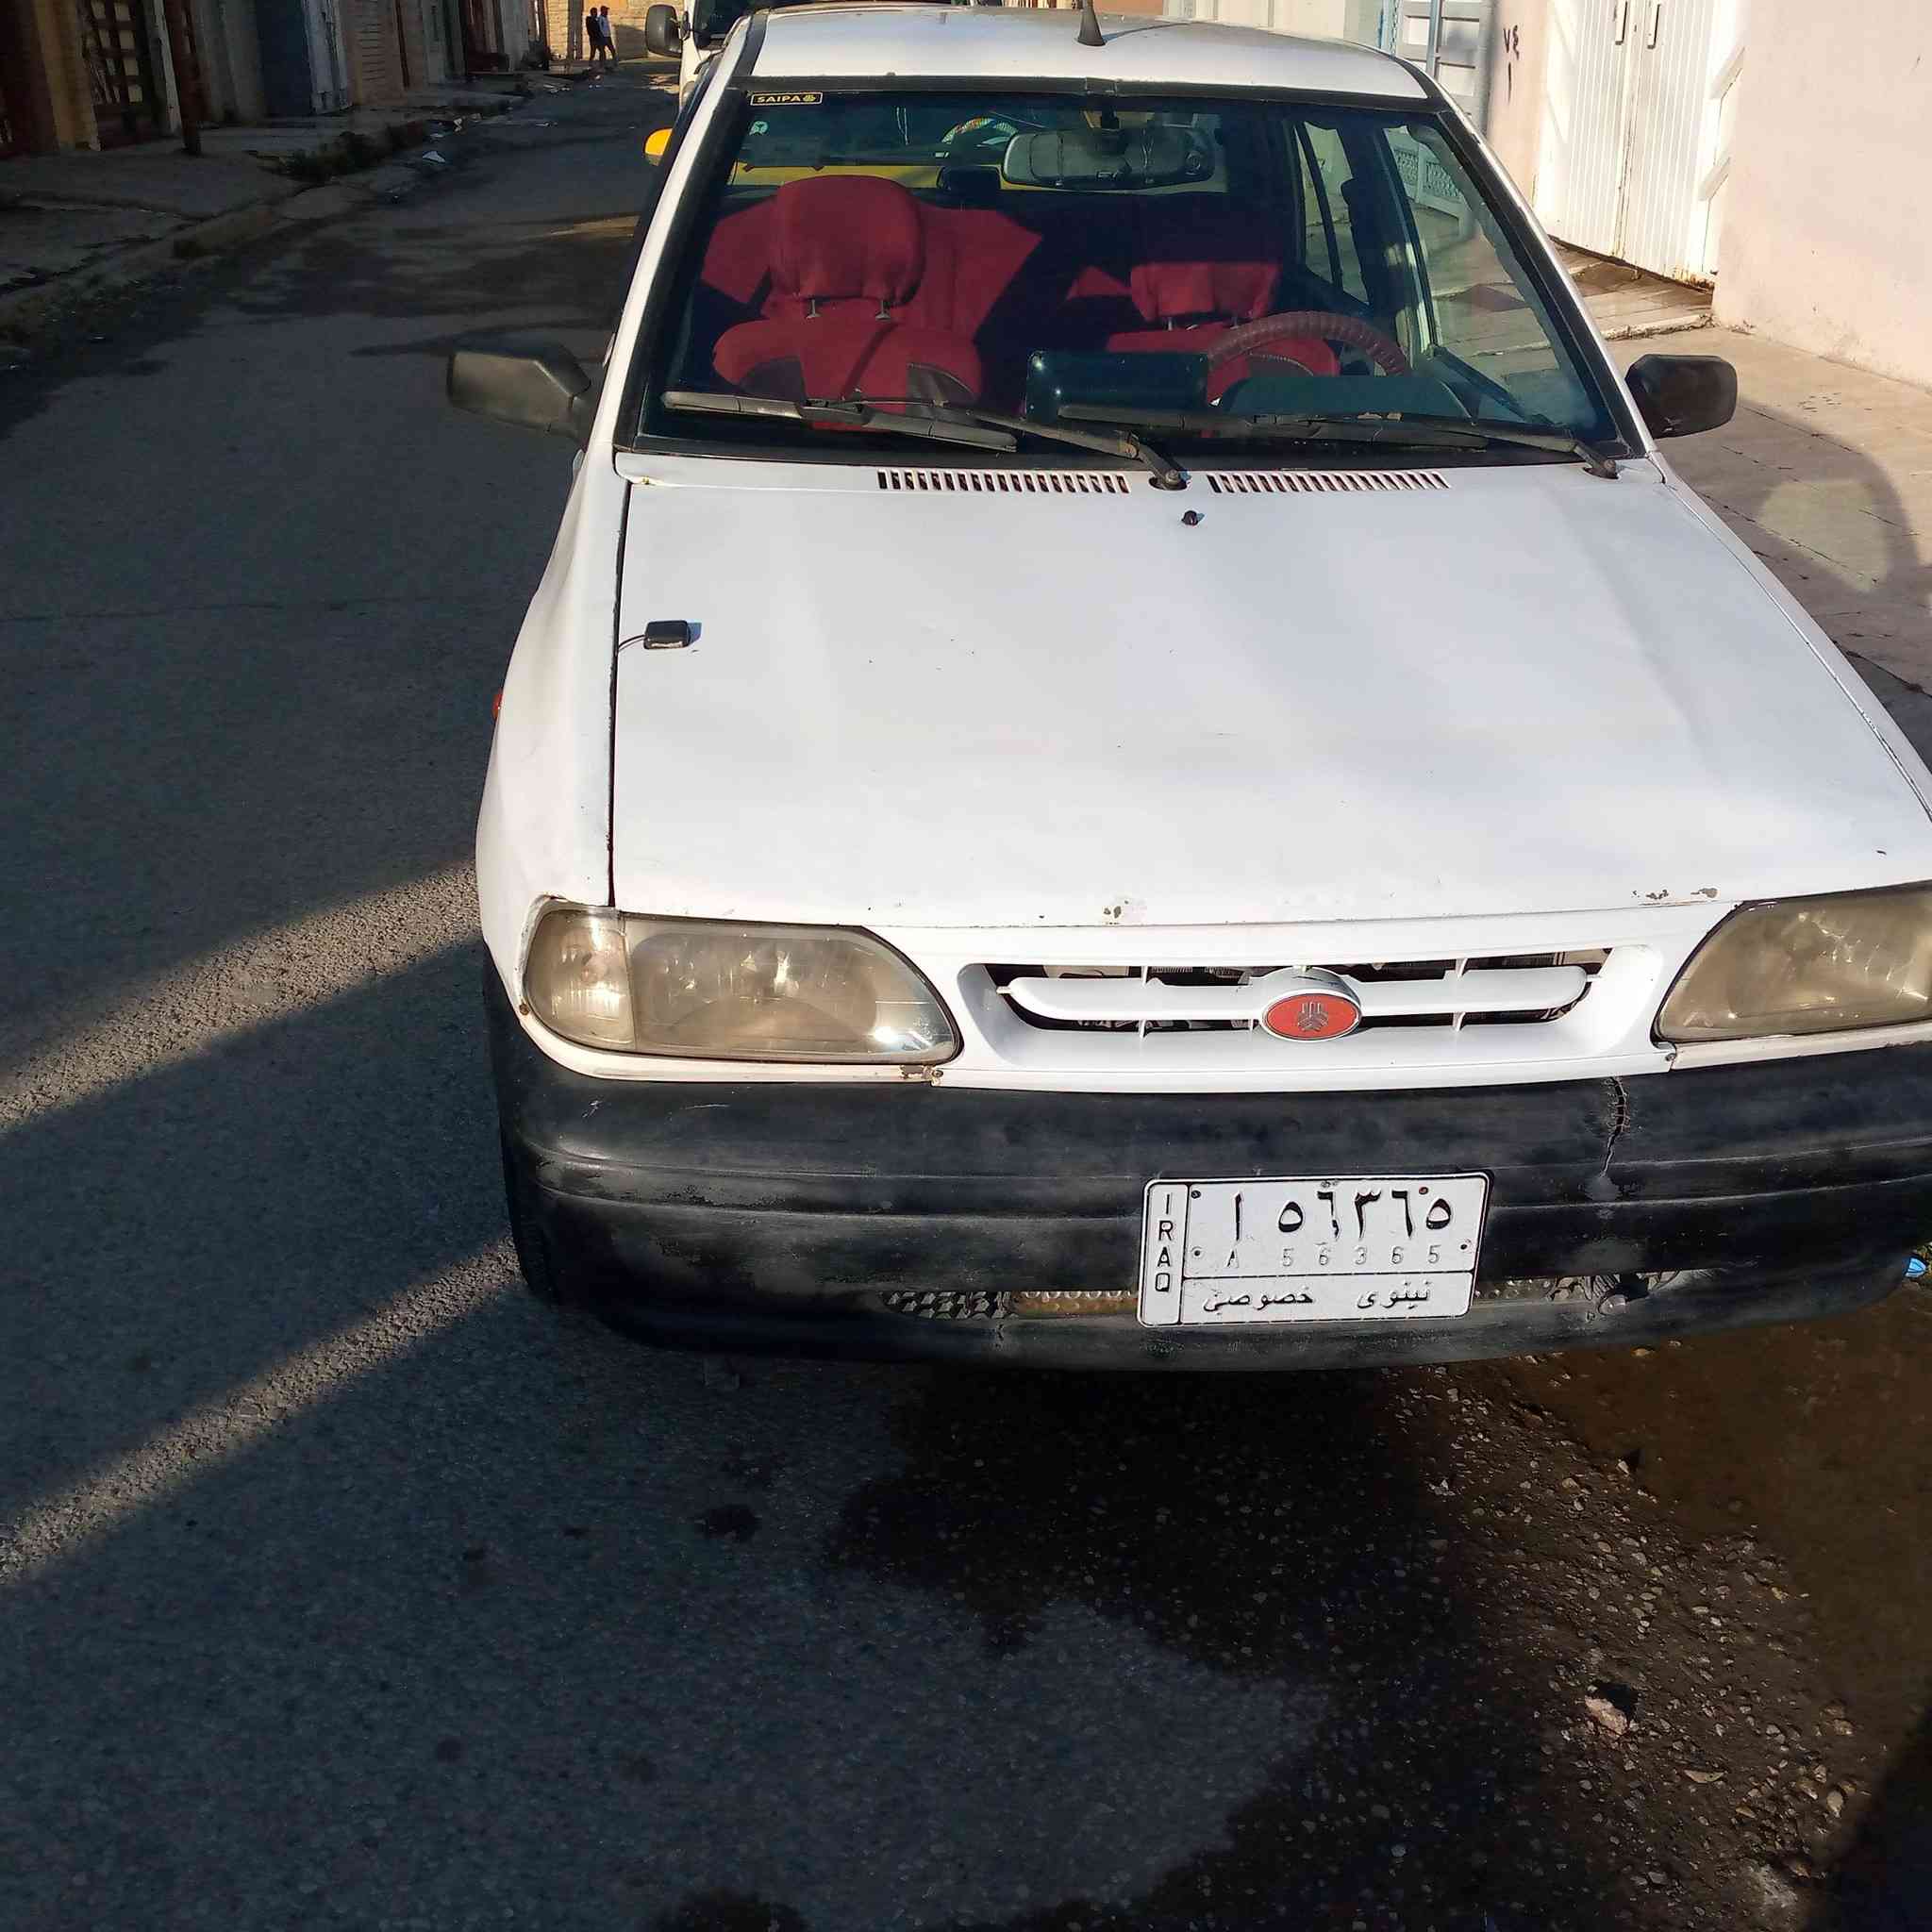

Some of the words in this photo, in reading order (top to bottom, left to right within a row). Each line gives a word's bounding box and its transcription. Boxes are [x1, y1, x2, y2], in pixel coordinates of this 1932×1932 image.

[1154, 1192, 1174, 1293] IRAQ
[1281, 1244, 1442, 1268] 56365
[1203, 1285, 1314, 1316] خصوصي
[1357, 1279, 1432, 1311] نينوى
